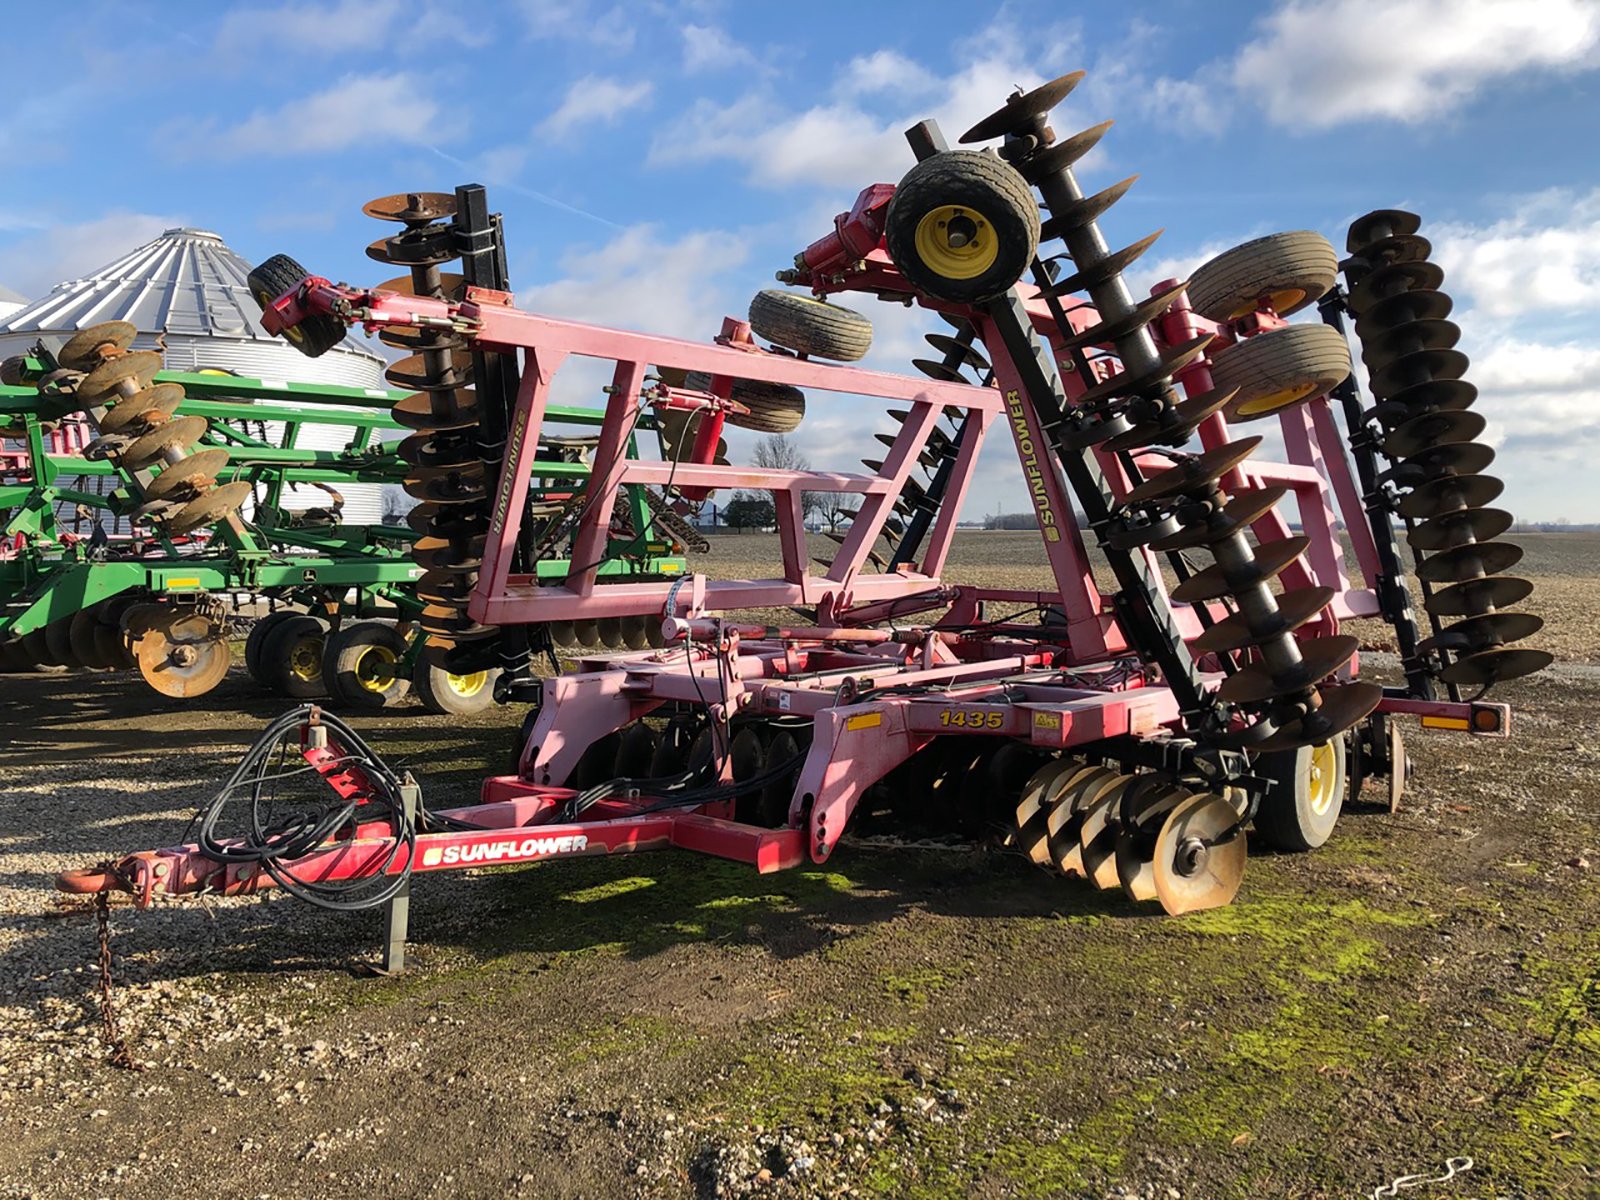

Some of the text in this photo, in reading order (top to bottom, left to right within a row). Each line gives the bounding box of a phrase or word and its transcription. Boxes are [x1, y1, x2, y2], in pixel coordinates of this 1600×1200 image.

[493, 423, 524, 535] SUNFLOWER
[1006, 388, 1055, 526] SUNFLOWER
[939, 708, 1004, 729] 1435
[442, 835, 588, 864] SUNFLOWER
